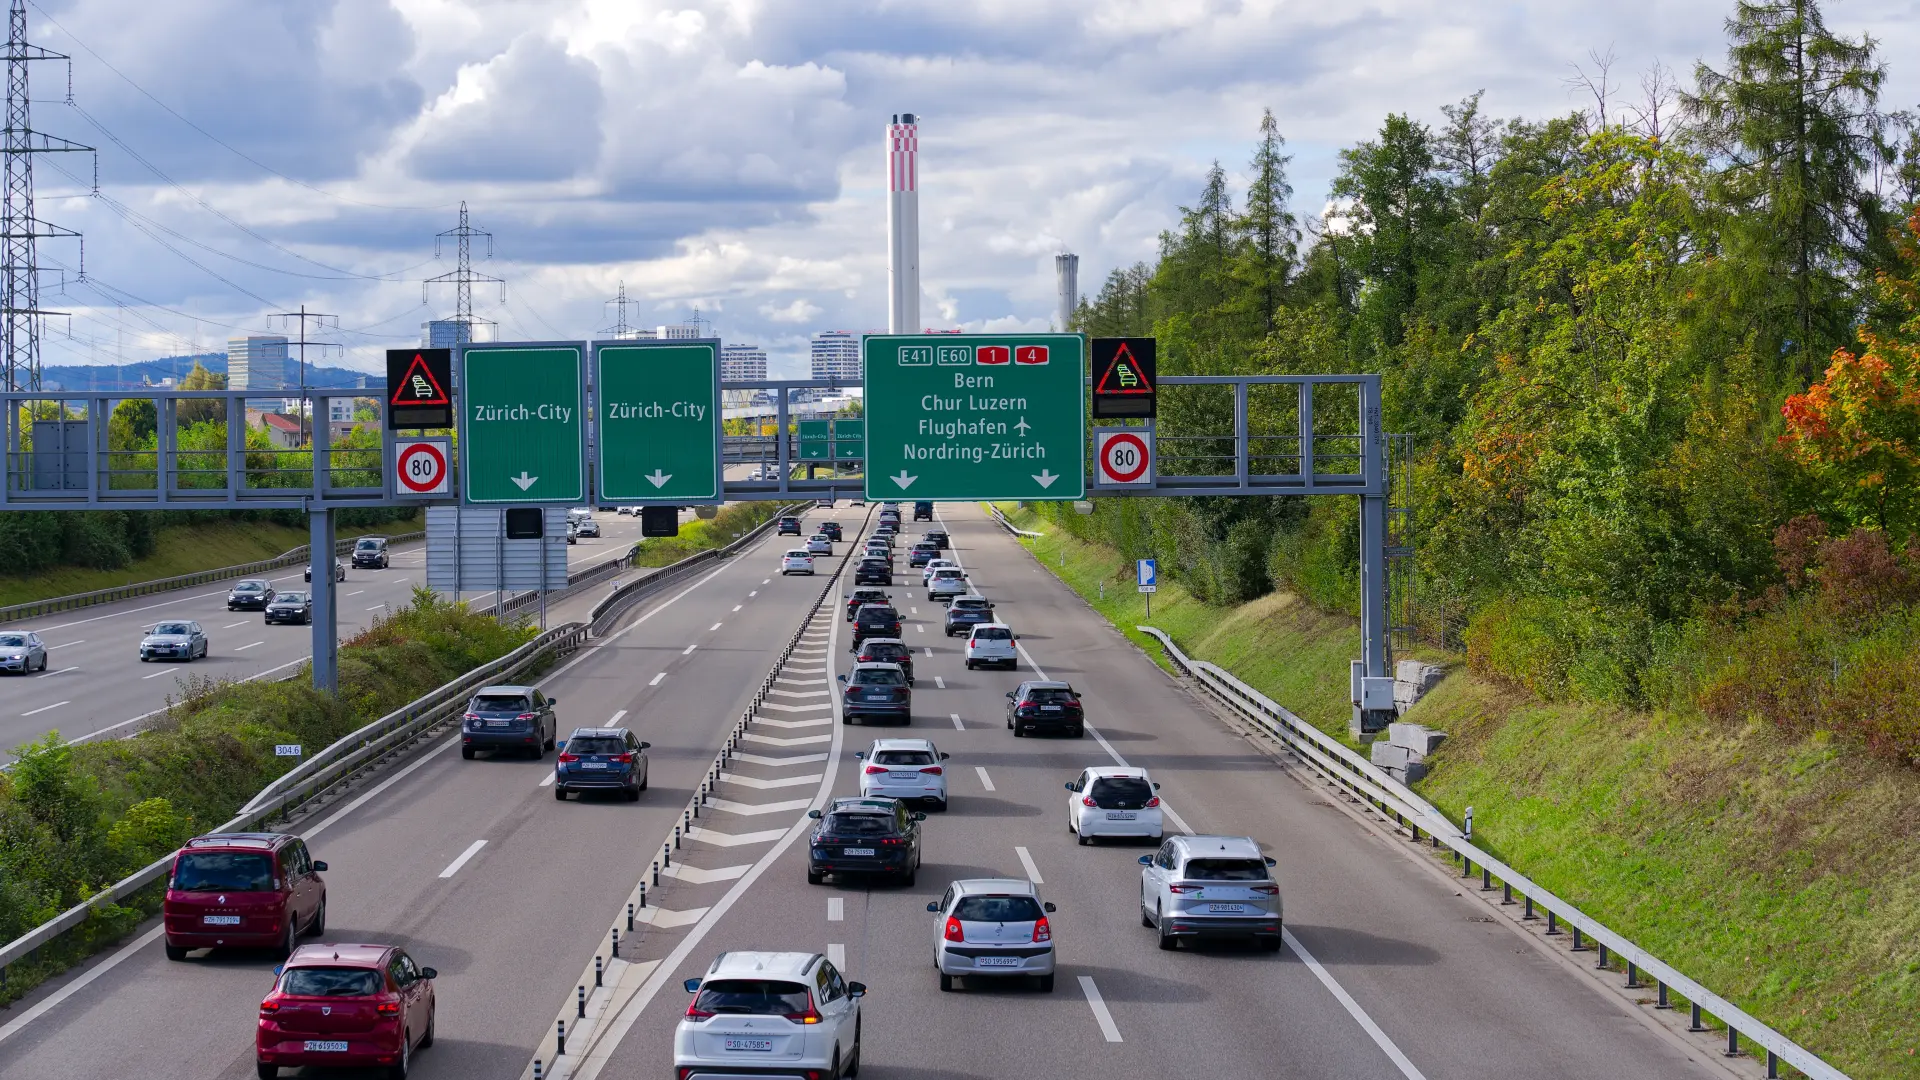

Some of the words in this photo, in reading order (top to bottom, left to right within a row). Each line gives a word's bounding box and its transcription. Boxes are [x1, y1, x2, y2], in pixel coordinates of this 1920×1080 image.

[990, 349, 996, 362] 1
[1028, 349, 1037, 362] 4
[954, 372, 995, 389] Bern
[921, 394, 963, 411] Chur
[969, 394, 1028, 411] Luzern
[475, 404, 572, 424] Zürich-City
[609, 401, 706, 422] Zürich-City
[919, 417, 1008, 439] Flughafen
[904, 442, 1047, 463] Nordring-Zürich
[1114, 449, 1135, 466] 80
[412, 459, 432, 476] 80
[277, 746, 300, 755] 304.6
